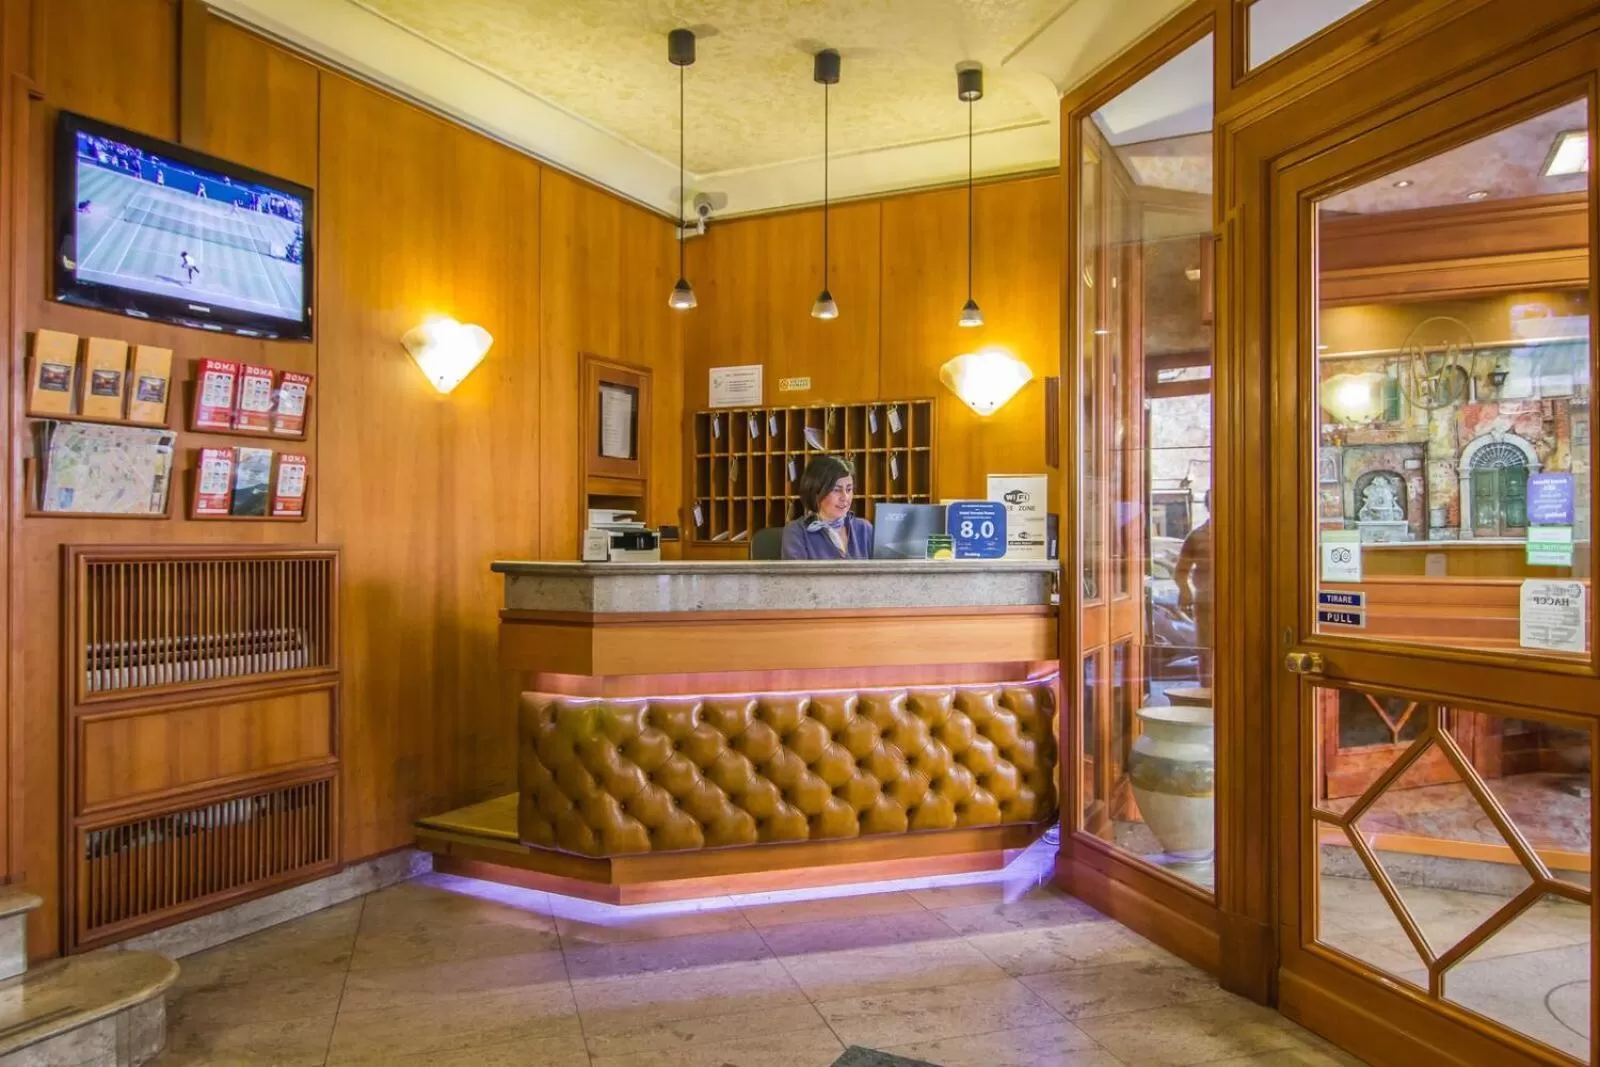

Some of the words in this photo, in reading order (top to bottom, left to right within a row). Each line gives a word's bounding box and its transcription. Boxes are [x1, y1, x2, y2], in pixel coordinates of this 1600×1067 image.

[206, 360, 235, 372] ROMA
[246, 366, 273, 377] ROMA
[284, 373, 310, 383] ROMA
[282, 454, 307, 463] ROMA
[960, 520, 995, 539] 8,0
[1326, 595, 1353, 604] TIRARE
[1327, 612, 1352, 623] PULL
